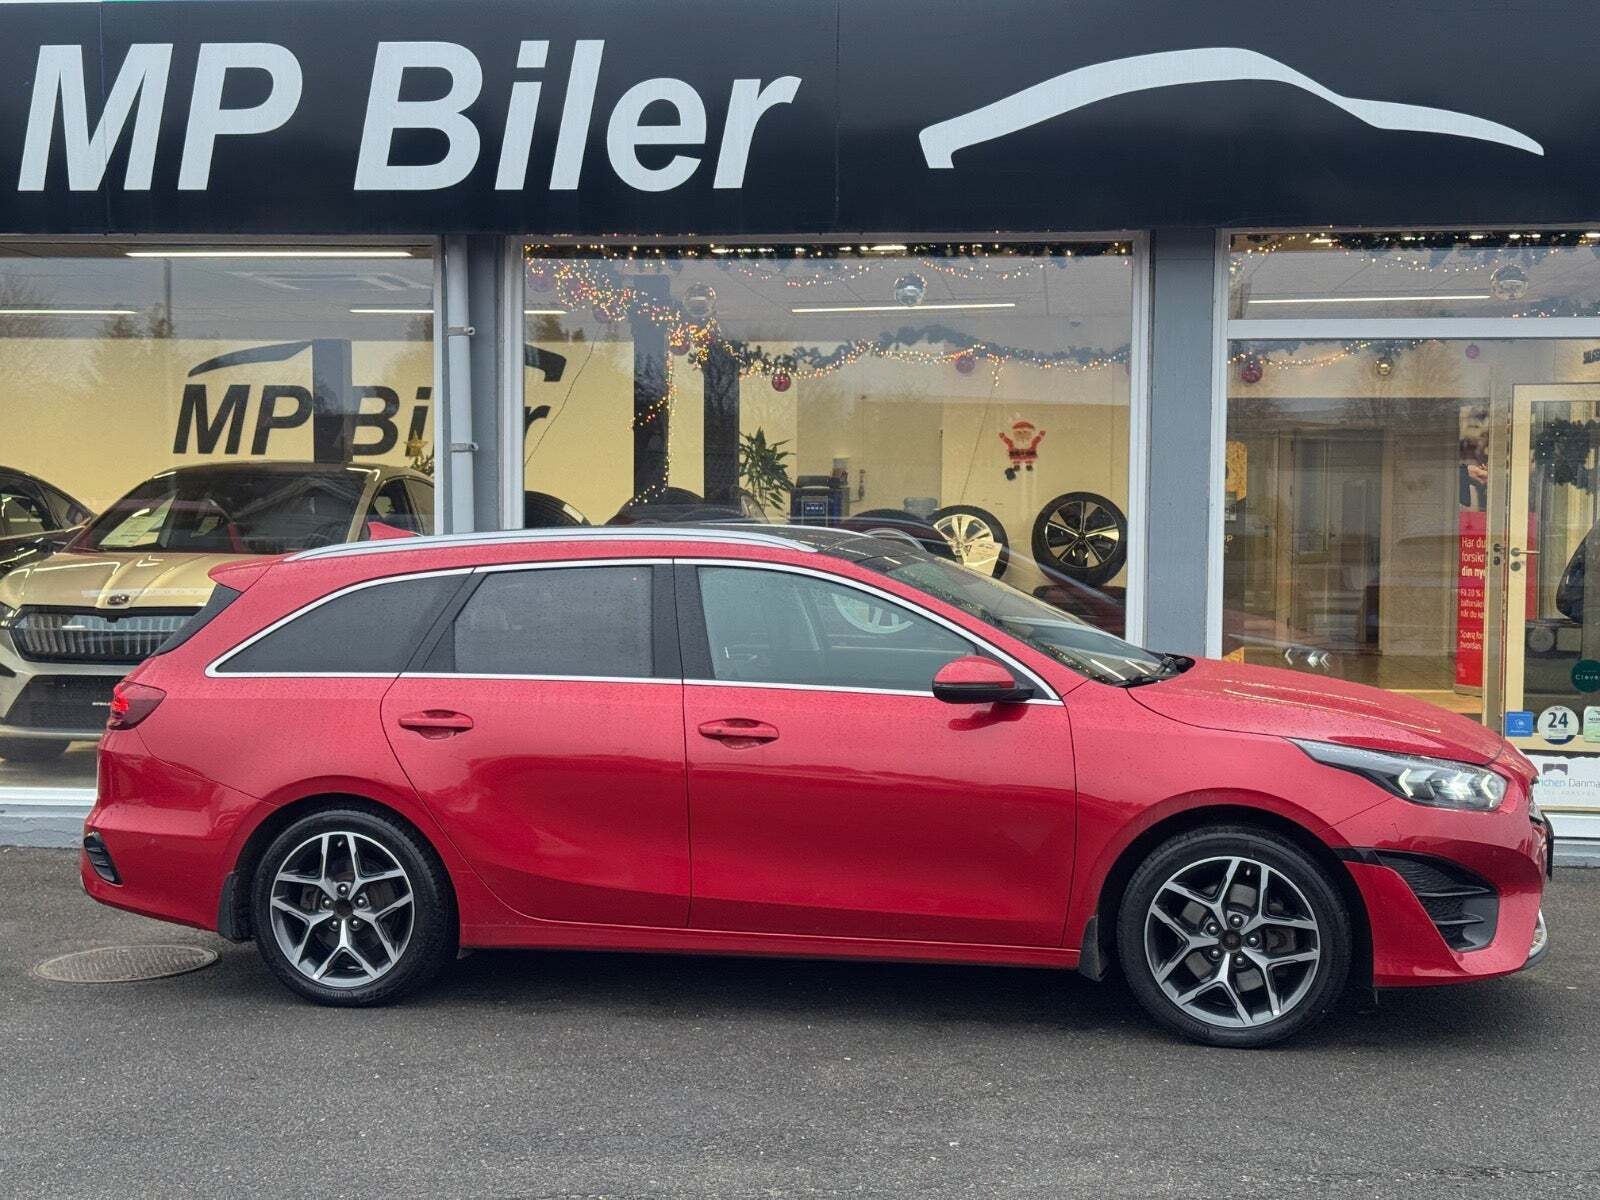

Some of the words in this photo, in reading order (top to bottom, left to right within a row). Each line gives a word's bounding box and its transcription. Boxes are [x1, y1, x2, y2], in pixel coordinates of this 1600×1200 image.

[18, 42, 303, 192] MP
[353, 39, 802, 192] Biler
[172, 384, 313, 455] MP
[1461, 566, 1475, 577] din
[1548, 712, 1569, 729] 24
